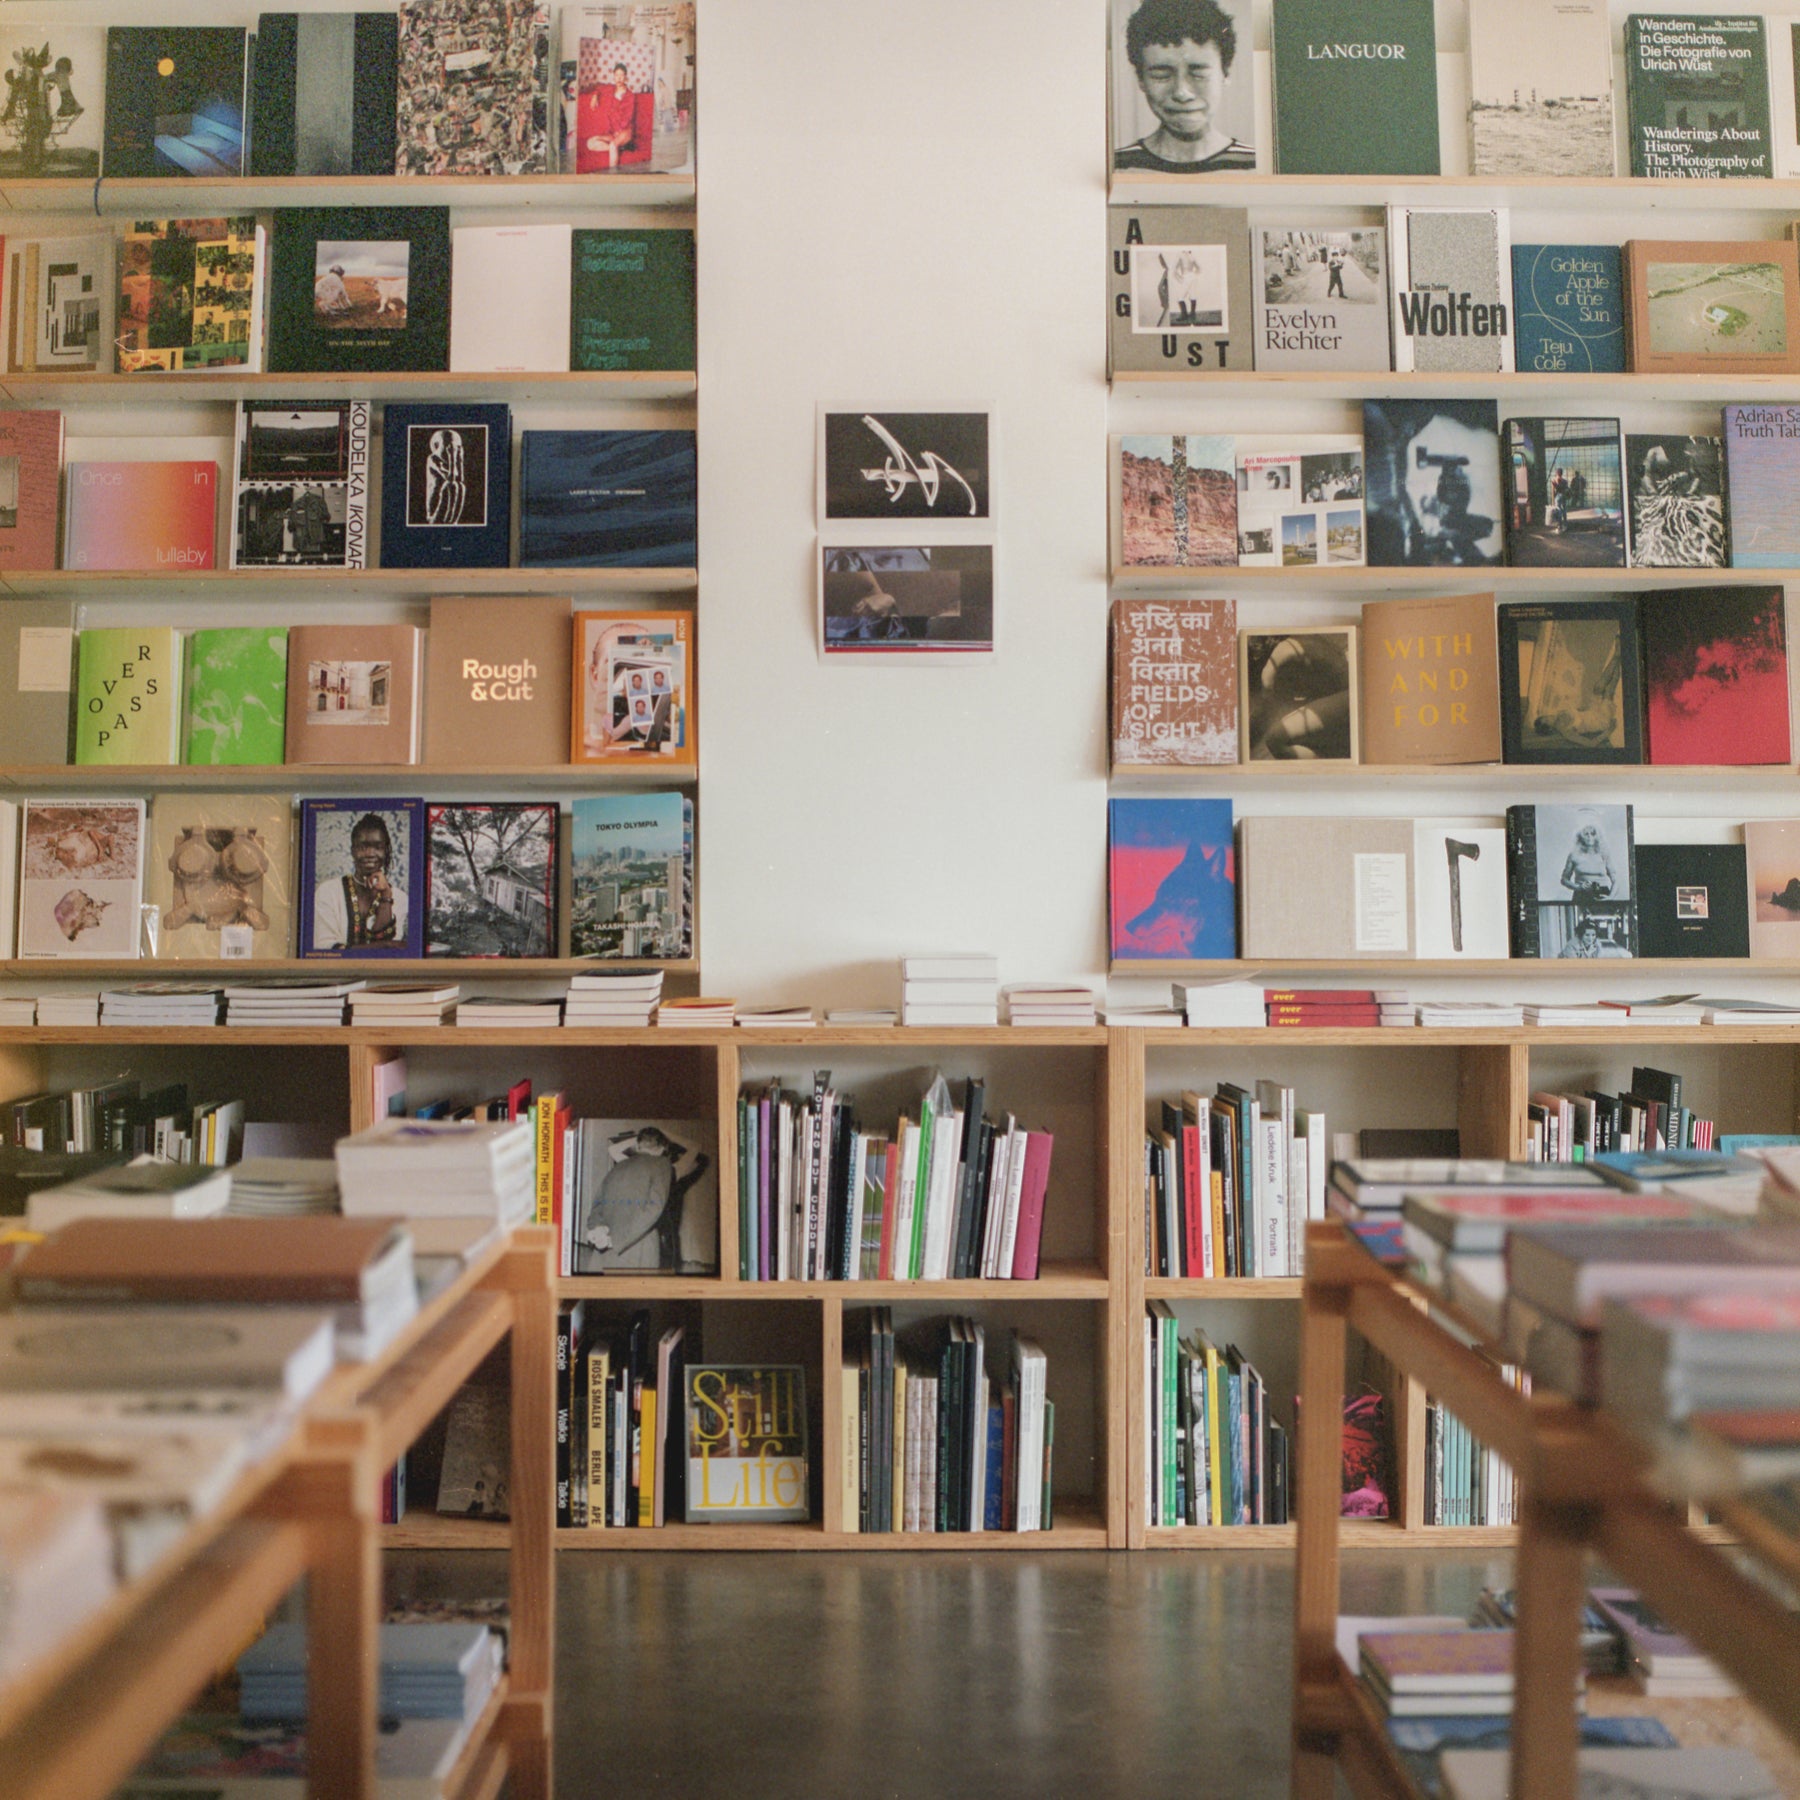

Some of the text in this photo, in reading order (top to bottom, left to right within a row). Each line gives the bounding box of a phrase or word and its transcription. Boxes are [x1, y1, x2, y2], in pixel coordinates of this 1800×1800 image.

[1638, 19, 1695, 31] Wandern
[1640, 32, 1727, 45] in Geschichte.
[1307, 44, 1406, 60] LANGUOR
[1640, 46, 1751, 61] Die Fotografie von
[1641, 59, 1712, 71] Ulrich Wüst
[1642, 127, 1760, 142] Wanderings About
[1644, 140, 1694, 155] History.
[1644, 154, 1766, 169] The Photography of
[1646, 167, 1720, 178] Ulrich Wüst
[1550, 257, 1604, 273] Golden
[1566, 274, 1610, 291] Apple
[1555, 291, 1603, 306] of the
[1265, 309, 1336, 334] Evelyn
[1399, 292, 1507, 337] Wolfen
[1579, 306, 1610, 322] Sun
[582, 319, 610, 333] The
[582, 335, 650, 352] Pregnant
[1265, 330, 1342, 350] Richter
[1539, 338, 1573, 355] Teju
[580, 353, 629, 369] Virgin
[1534, 355, 1567, 371] Cole
[1735, 409, 1783, 423] Adrian
[1735, 424, 1774, 438] Truth
[350, 401, 368, 497] KOUDELKA
[79, 469, 209, 486] Once in
[77, 547, 207, 565] a lullaby
[1129, 604, 1213, 637] दृष्टि का
[1130, 632, 1184, 656] अनंत
[1384, 632, 1472, 661] WITH
[463, 658, 537, 684] Rough
[1129, 657, 1201, 683] विस्तार
[1390, 668, 1469, 695] AND
[1131, 685, 1209, 702] FIELDS
[1130, 703, 1162, 721] OF
[1394, 703, 1469, 728] FOR
[1129, 722, 1200, 739] SIGHT
[596, 820, 658, 831] TOKYO OLYMPIA
[542, 1102, 550, 1118] JON
[541, 1122, 550, 1162] HORVATH
[809, 1085, 823, 1249] NOTHING BUT CLOUDS
[540, 1173, 549, 1192] THIS
[540, 1196, 548, 1204] IS
[1268, 1126, 1278, 1257] Liedeke Kruk Portraits
[693, 1370, 799, 1440] Still
[556, 1335, 568, 1509] Skopje Walkie Talkie
[591, 1360, 602, 1524] ROSA SMALEN BERLIN APE
[695, 1439, 800, 1509] Life
